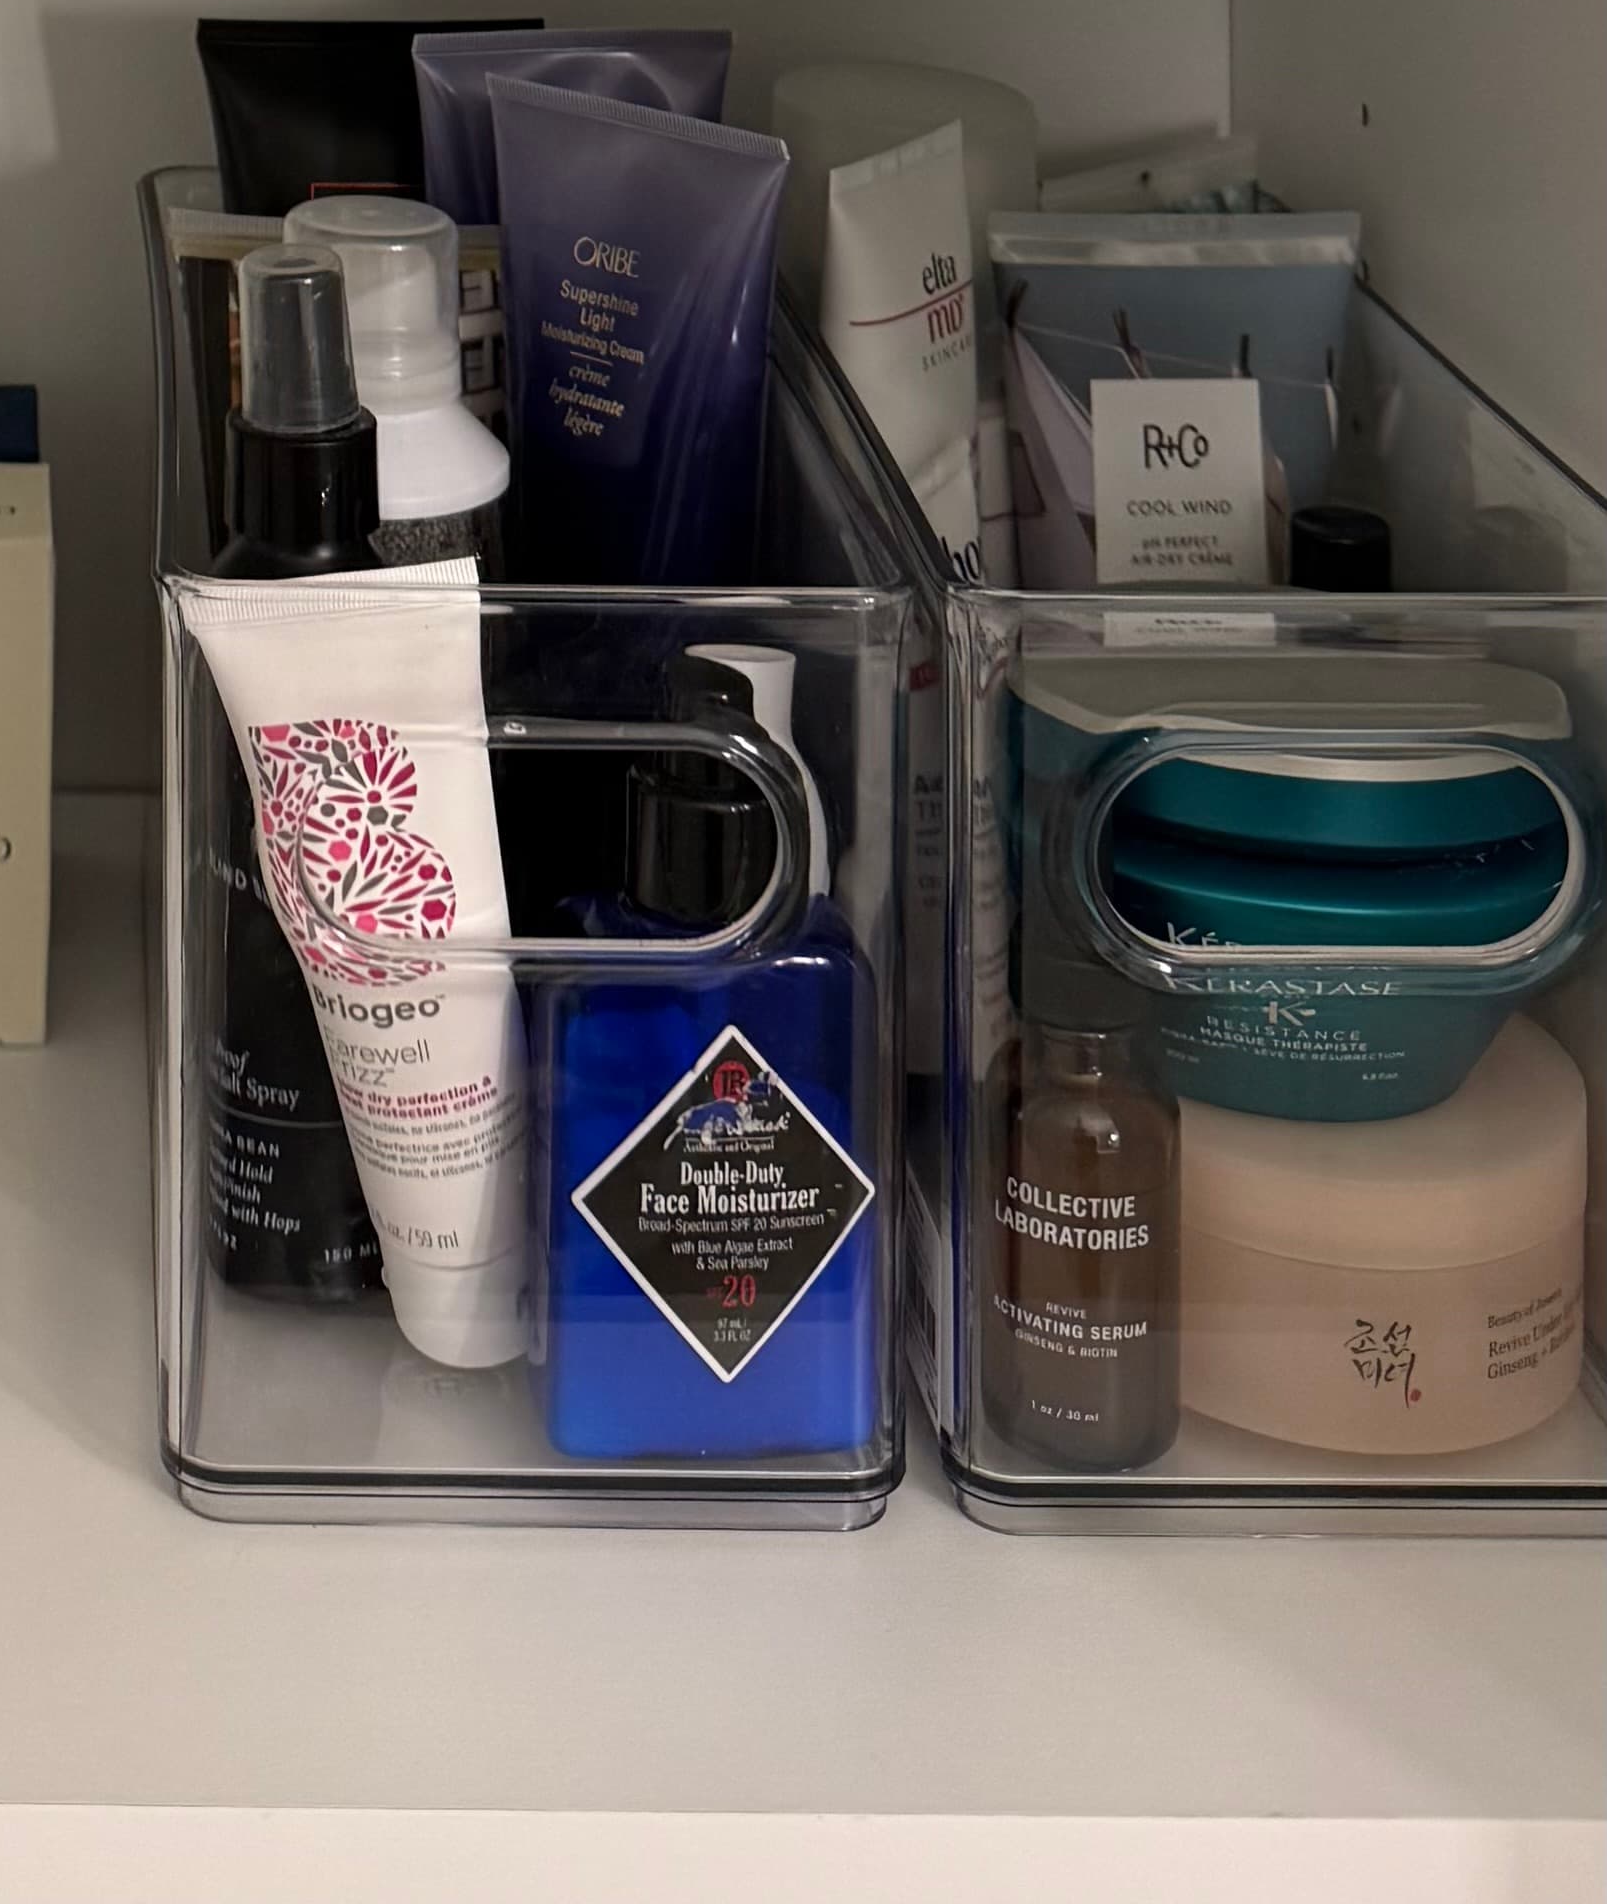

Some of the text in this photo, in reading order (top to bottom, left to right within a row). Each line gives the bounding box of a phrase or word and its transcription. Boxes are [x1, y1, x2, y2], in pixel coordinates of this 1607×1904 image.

[573, 236, 641, 278] ORIBE
[922, 251, 957, 295] elta
[560, 279, 639, 317] Supershine
[579, 307, 616, 333] Light
[1143, 423, 1210, 470] R+Co
[1126, 499, 1233, 517] COOL WIND
[245, 1076, 301, 1113] Spray
[368, 1080, 479, 1107] dry perfection
[367, 1102, 449, 1120] protectant
[680, 1159, 785, 1187] Double-Duty
[640, 1182, 821, 1215] Face Moisturizer
[1006, 1176, 1136, 1220] COLLECTIVE
[263, 1210, 302, 1236] Hops
[638, 1212, 825, 1235] Broad-Spectrum SPF 20 Sunscreen
[994, 1198, 1150, 1251] LABORATORIES
[436, 1229, 459, 1249] ml
[671, 1236, 794, 1257] with Blue Algae Extract
[707, 1255, 728, 1270] Sea
[731, 1255, 770, 1272] Parsley
[722, 1274, 756, 1308] 20
[993, 1294, 1148, 1341] ACTIVATING SERUM
[1045, 1301, 1087, 1320] REVIVE
[1014, 1326, 1064, 1354] GINSENG
[1080, 1345, 1118, 1359] BIOTIN
